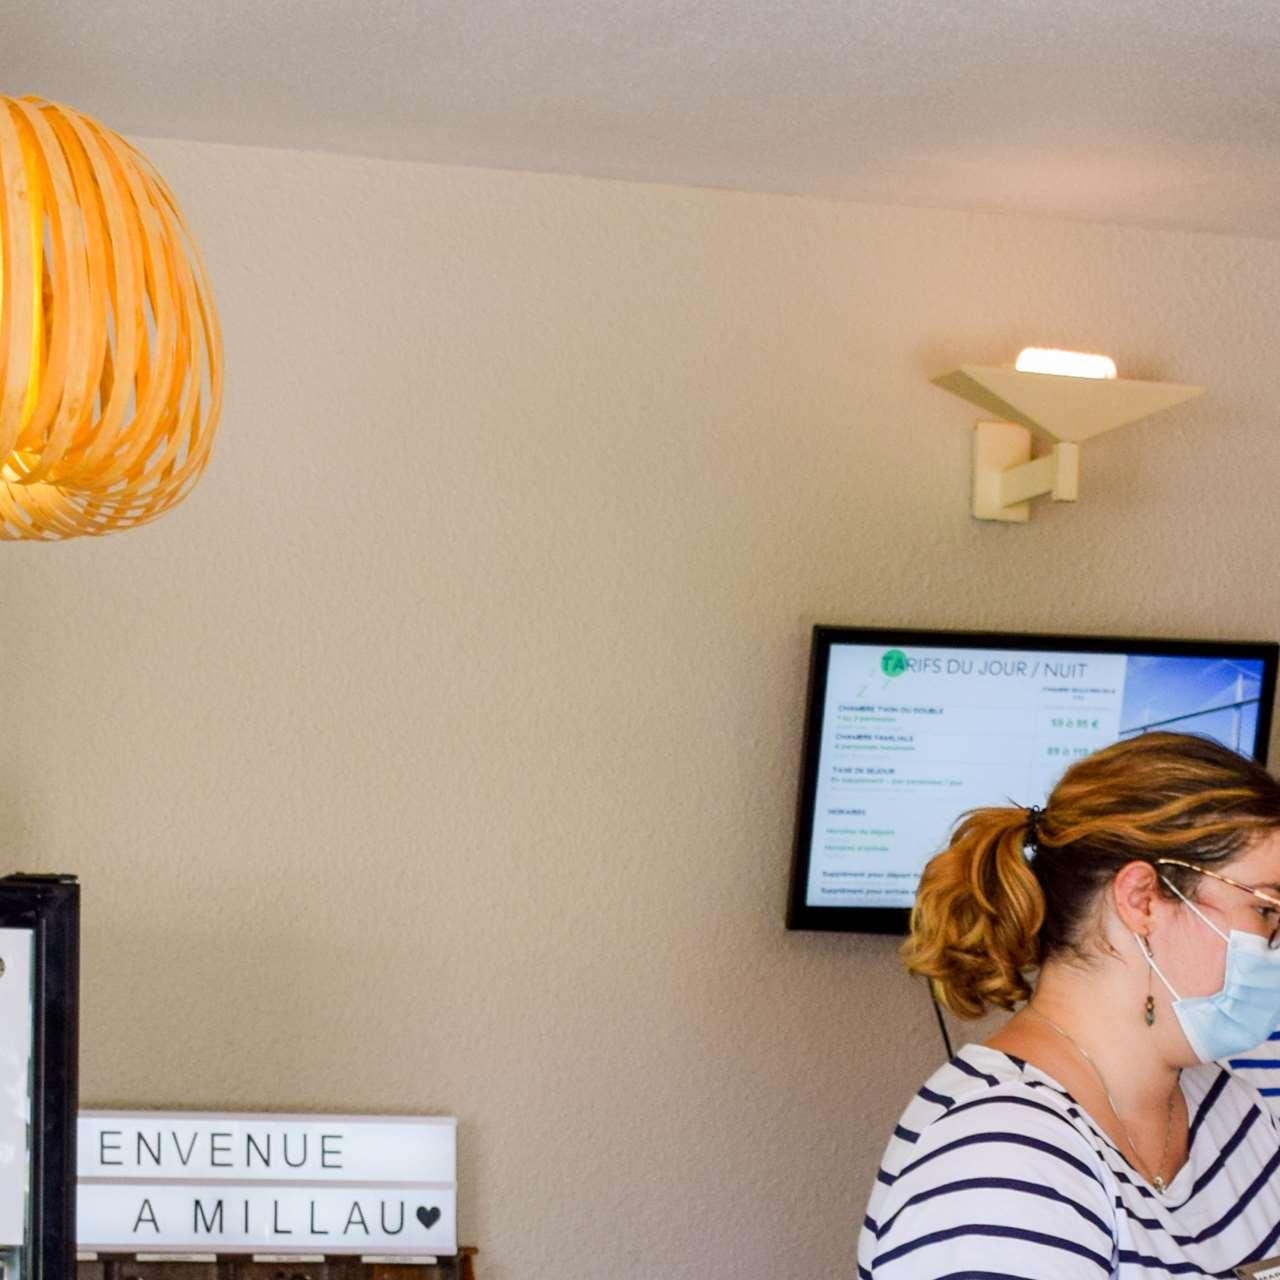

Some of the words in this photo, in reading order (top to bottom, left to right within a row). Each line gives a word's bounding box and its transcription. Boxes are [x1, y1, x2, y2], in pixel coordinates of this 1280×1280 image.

[882, 655, 942, 674] TARIFS
[946, 658, 973, 675] DU
[978, 660, 1026, 677] JOUR
[1044, 662, 1088, 679] NUIT
[99, 1130, 344, 1168] ENVENUE
[133, 1199, 160, 1234] A
[193, 1199, 405, 1235] MILLAU
